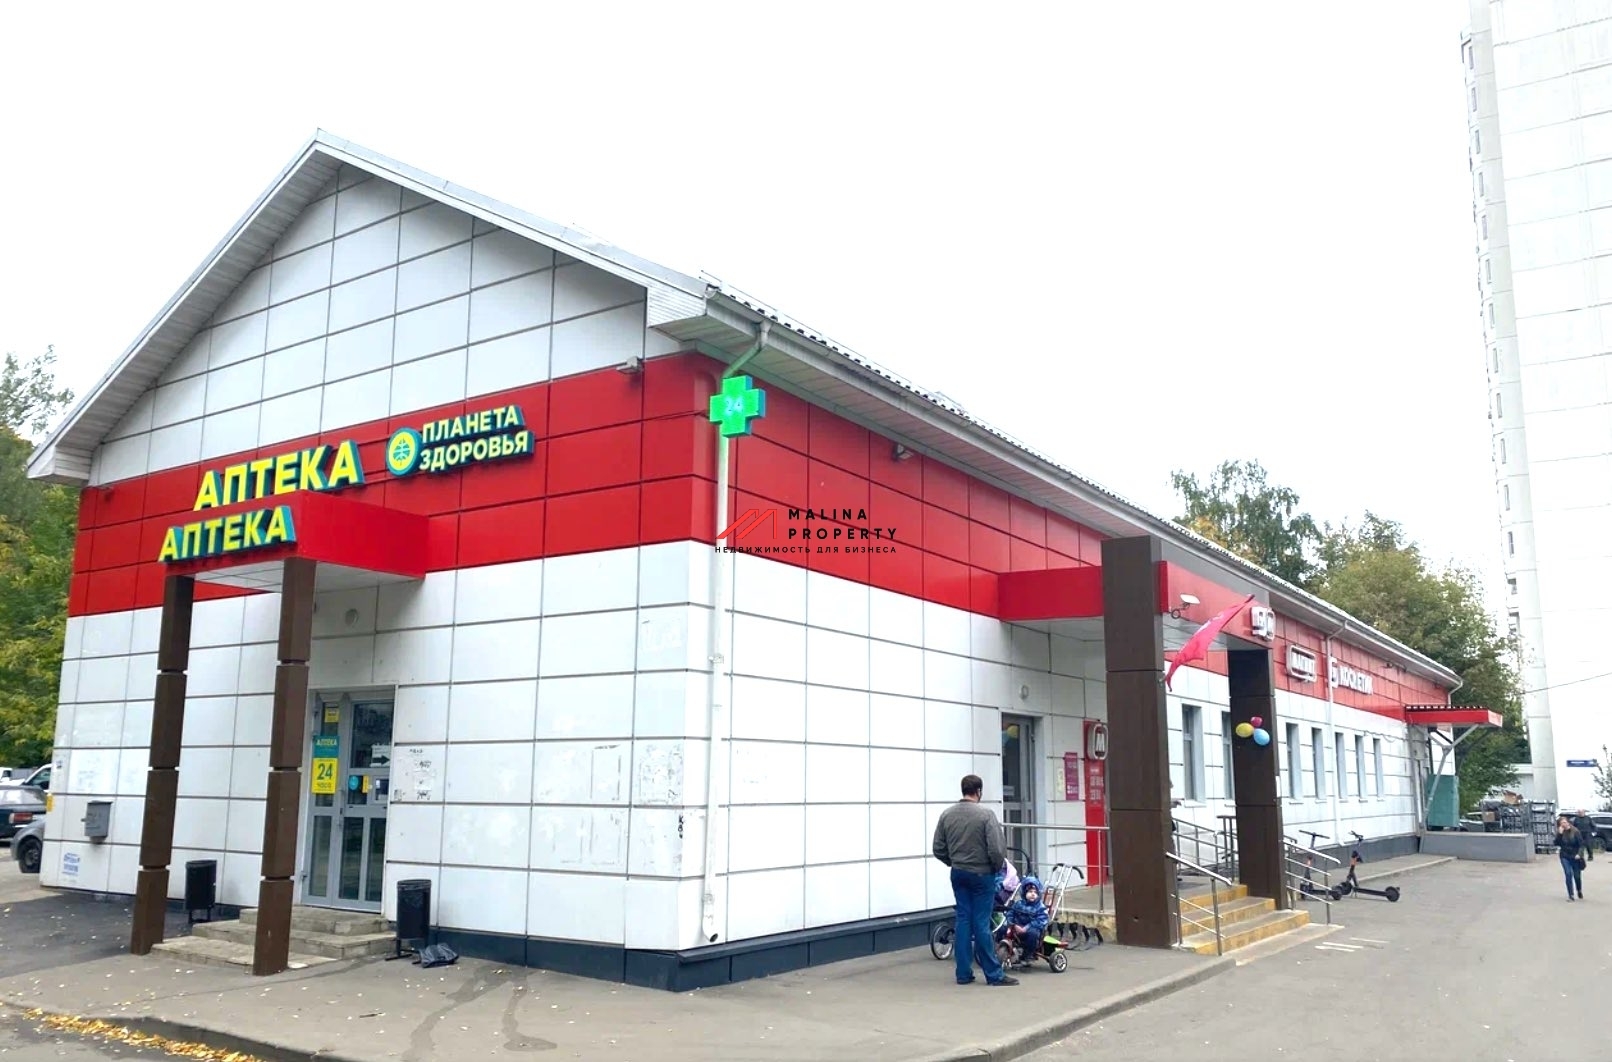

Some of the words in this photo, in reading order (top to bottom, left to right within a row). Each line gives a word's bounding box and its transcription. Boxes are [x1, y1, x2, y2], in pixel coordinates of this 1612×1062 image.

[422, 405, 524, 443] ПЛАНЕТА
[418, 430, 531, 472] ЗДОРОВЬЯ
[193, 440, 363, 511] АПТЕКА
[158, 505, 294, 561] АПТЕКА
[316, 763, 333, 781] 24
